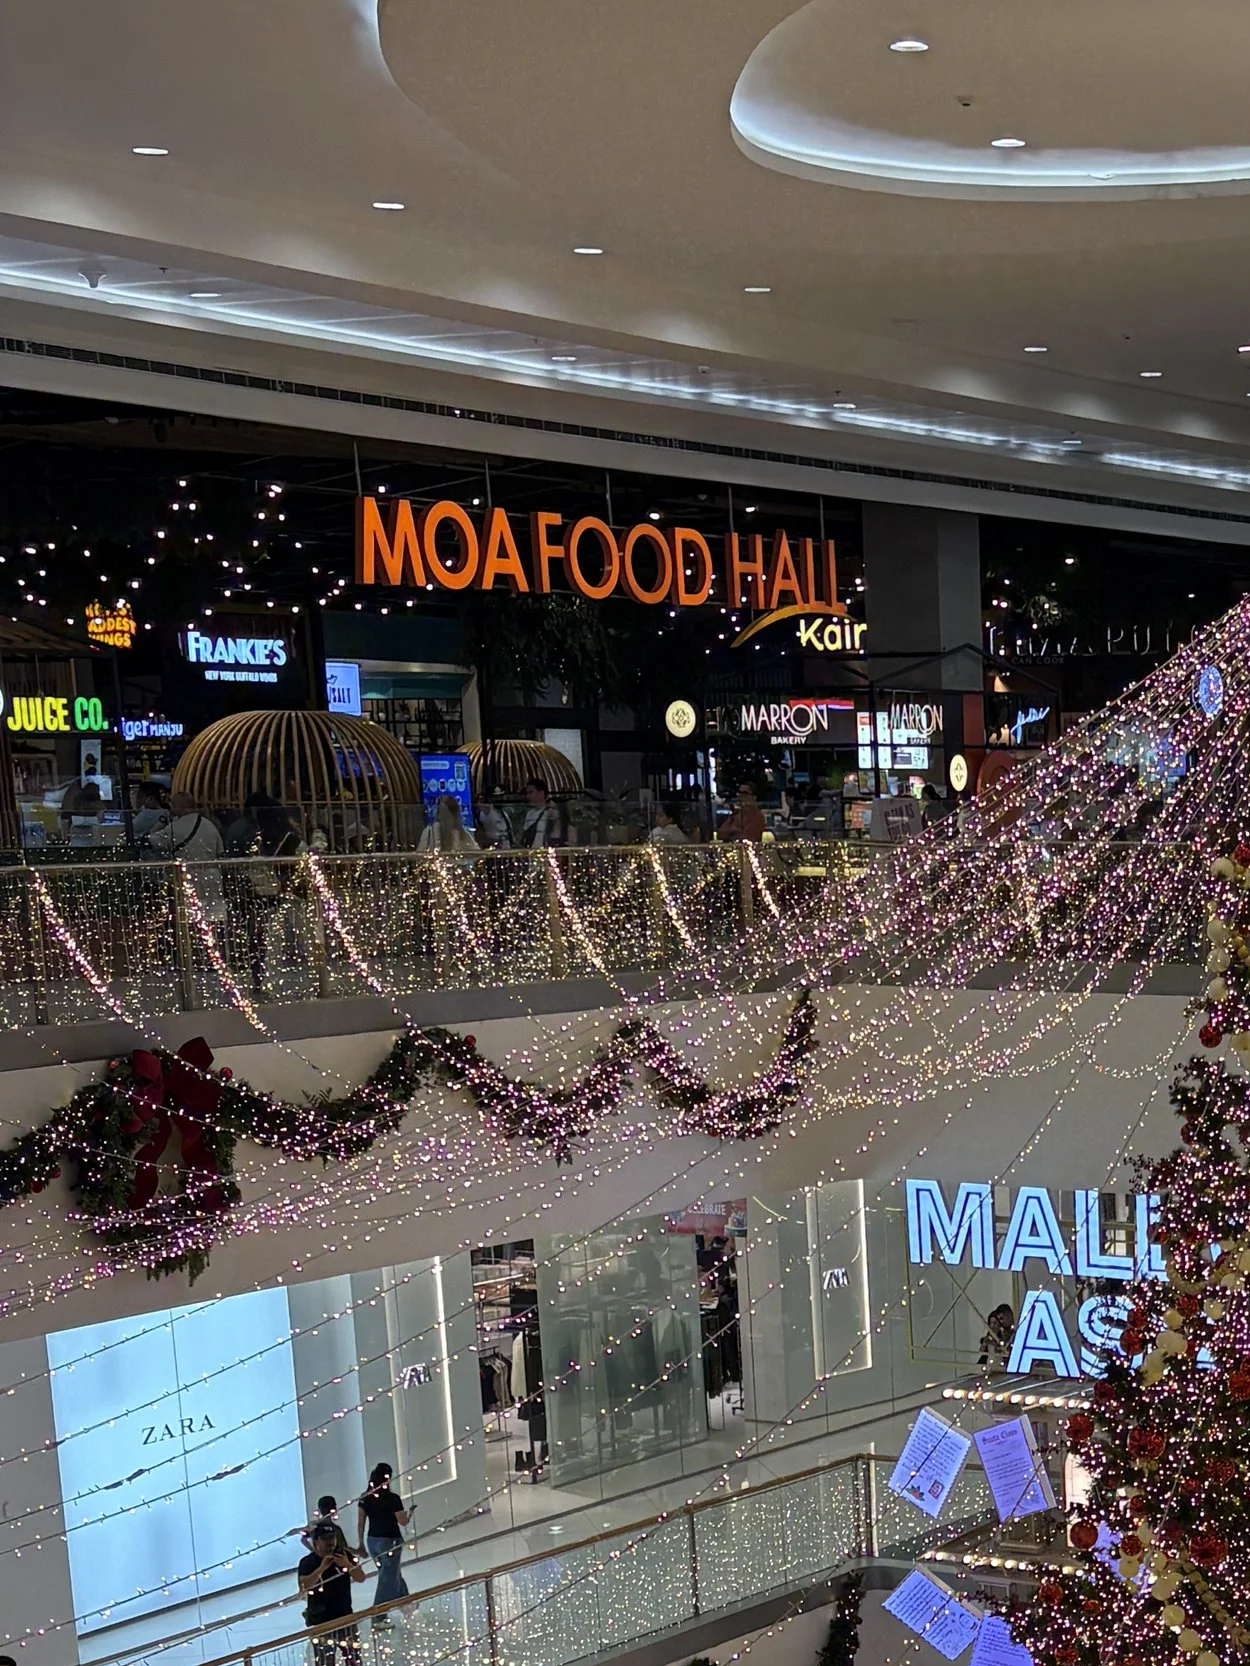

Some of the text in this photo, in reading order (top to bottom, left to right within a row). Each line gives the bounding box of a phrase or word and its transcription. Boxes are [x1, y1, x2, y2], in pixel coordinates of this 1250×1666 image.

[357, 496, 847, 612] MOA FOOD HALL
[187, 631, 287, 666] FRANKIE'S
[7, 696, 109, 731] JUICE CO.
[150, 721, 183, 737] MANJU
[741, 703, 829, 736] MARRON
[890, 703, 943, 737] MARRON
[771, 736, 807, 745] BAKERY
[142, 1414, 216, 1445] ZARA
